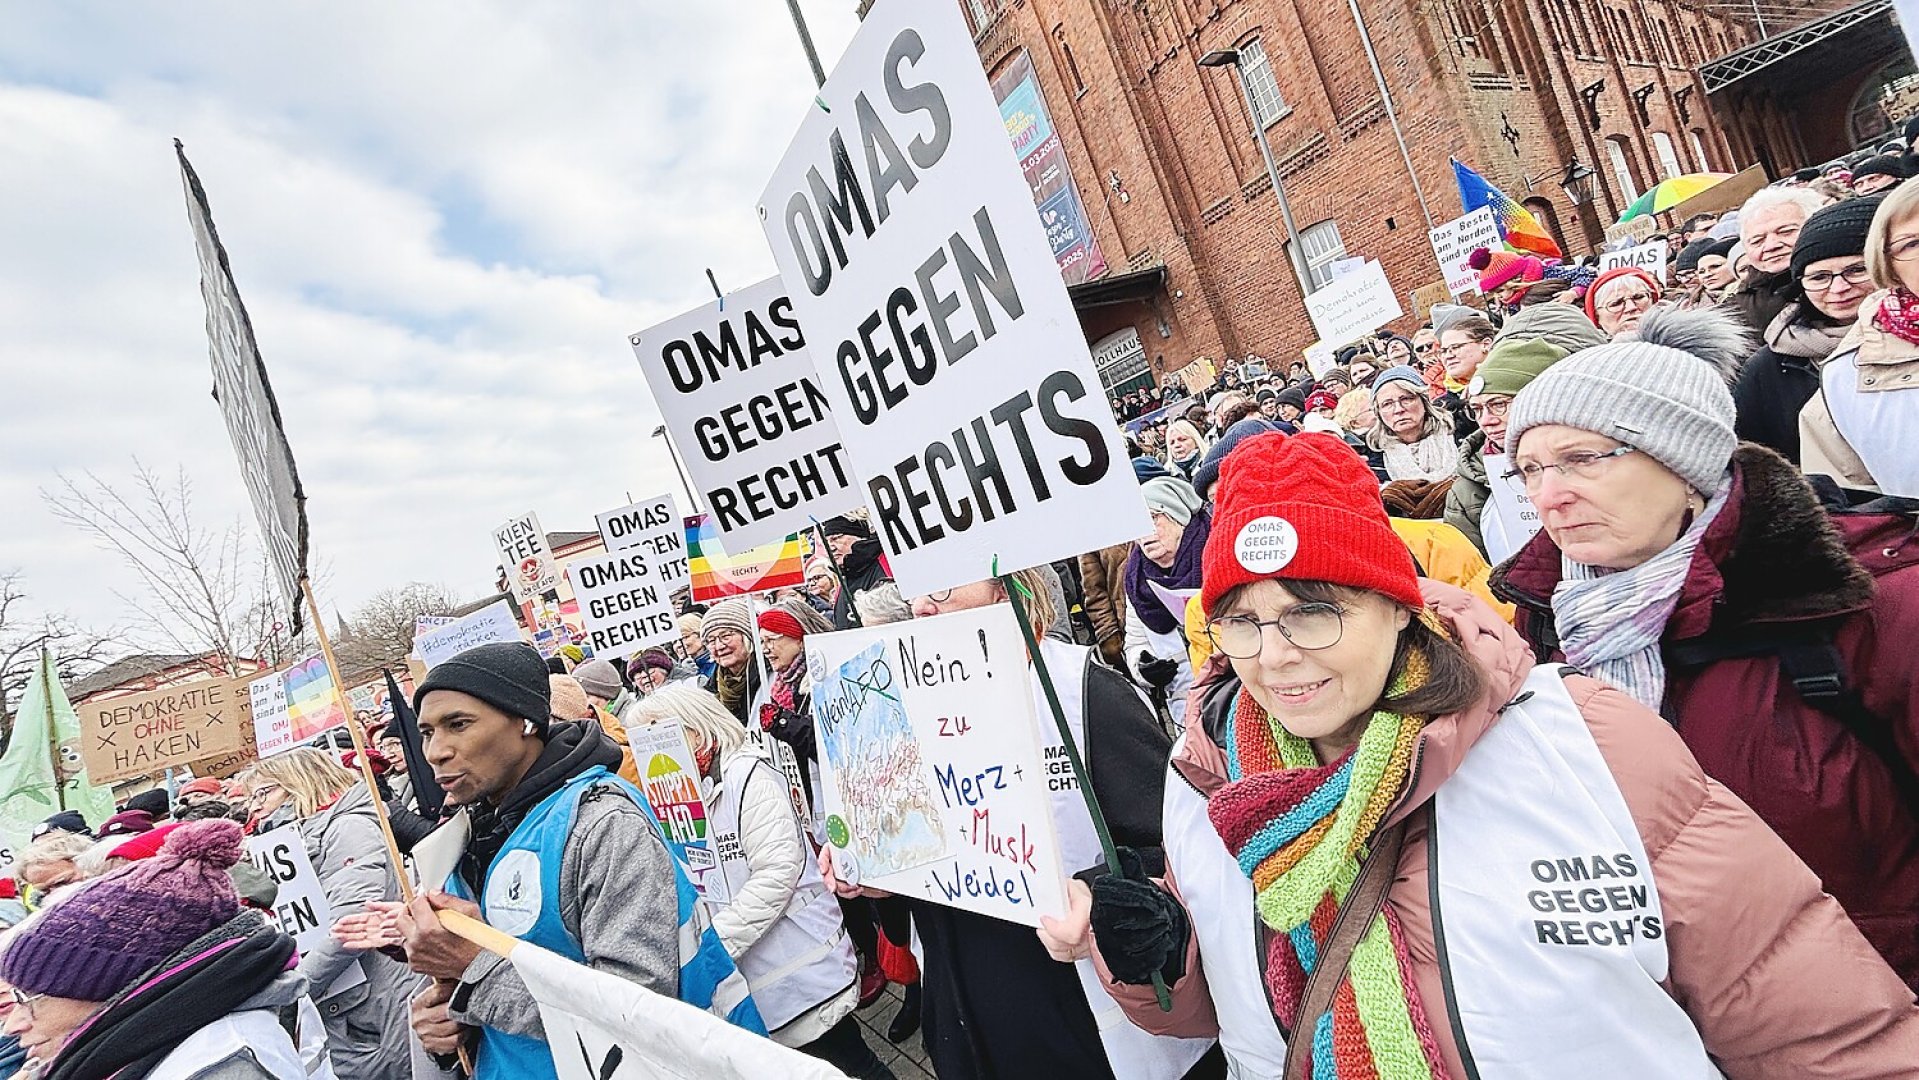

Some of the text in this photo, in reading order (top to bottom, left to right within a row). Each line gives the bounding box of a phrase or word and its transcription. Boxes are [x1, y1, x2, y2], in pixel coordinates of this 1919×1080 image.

[785, 27, 952, 296] OMAS
[1433, 213, 1489, 242] Das Beste
[1437, 224, 1493, 254] am Norden
[1441, 249, 1460, 264] sind
[1608, 248, 1657, 271] OMAS
[1449, 275, 1472, 290] GEGEN
[836, 205, 1024, 426] GEGEN
[662, 297, 806, 393] OMAS
[1096, 337, 1141, 367] OLLHAUS
[867, 370, 1110, 557] RECHTS
[707, 443, 848, 533] RECHT
[497, 517, 533, 547] KIEN
[608, 504, 671, 538] OMAS
[1248, 522, 1283, 533] OMAS
[503, 534, 542, 565] TEE
[1241, 550, 1287, 561] RECHTS
[1244, 536, 1285, 547] GEGEN
[579, 555, 648, 589] OMAS
[732, 565, 759, 577] RECHTS
[589, 585, 659, 619] GEGEN
[422, 618, 496, 654] #demokratie
[591, 613, 673, 652] RECHTS
[899, 628, 993, 688] Nein !
[252, 683, 270, 696] Das
[254, 698, 267, 708] am
[100, 685, 224, 729] DEMOKRATIE
[256, 706, 274, 720] sind
[134, 713, 186, 739] OHNE
[937, 715, 971, 737] zu
[115, 731, 201, 769] HAKEN
[260, 737, 282, 752] GEGEN
[206, 753, 238, 775] noch
[647, 772, 693, 808] STOPPT
[933, 763, 1007, 809] Merz
[665, 804, 698, 844] AFD
[972, 808, 1037, 874] Musk
[1530, 853, 1638, 883] OMAS
[932, 861, 1034, 907] Weidel
[1527, 885, 1647, 913] GEGEN
